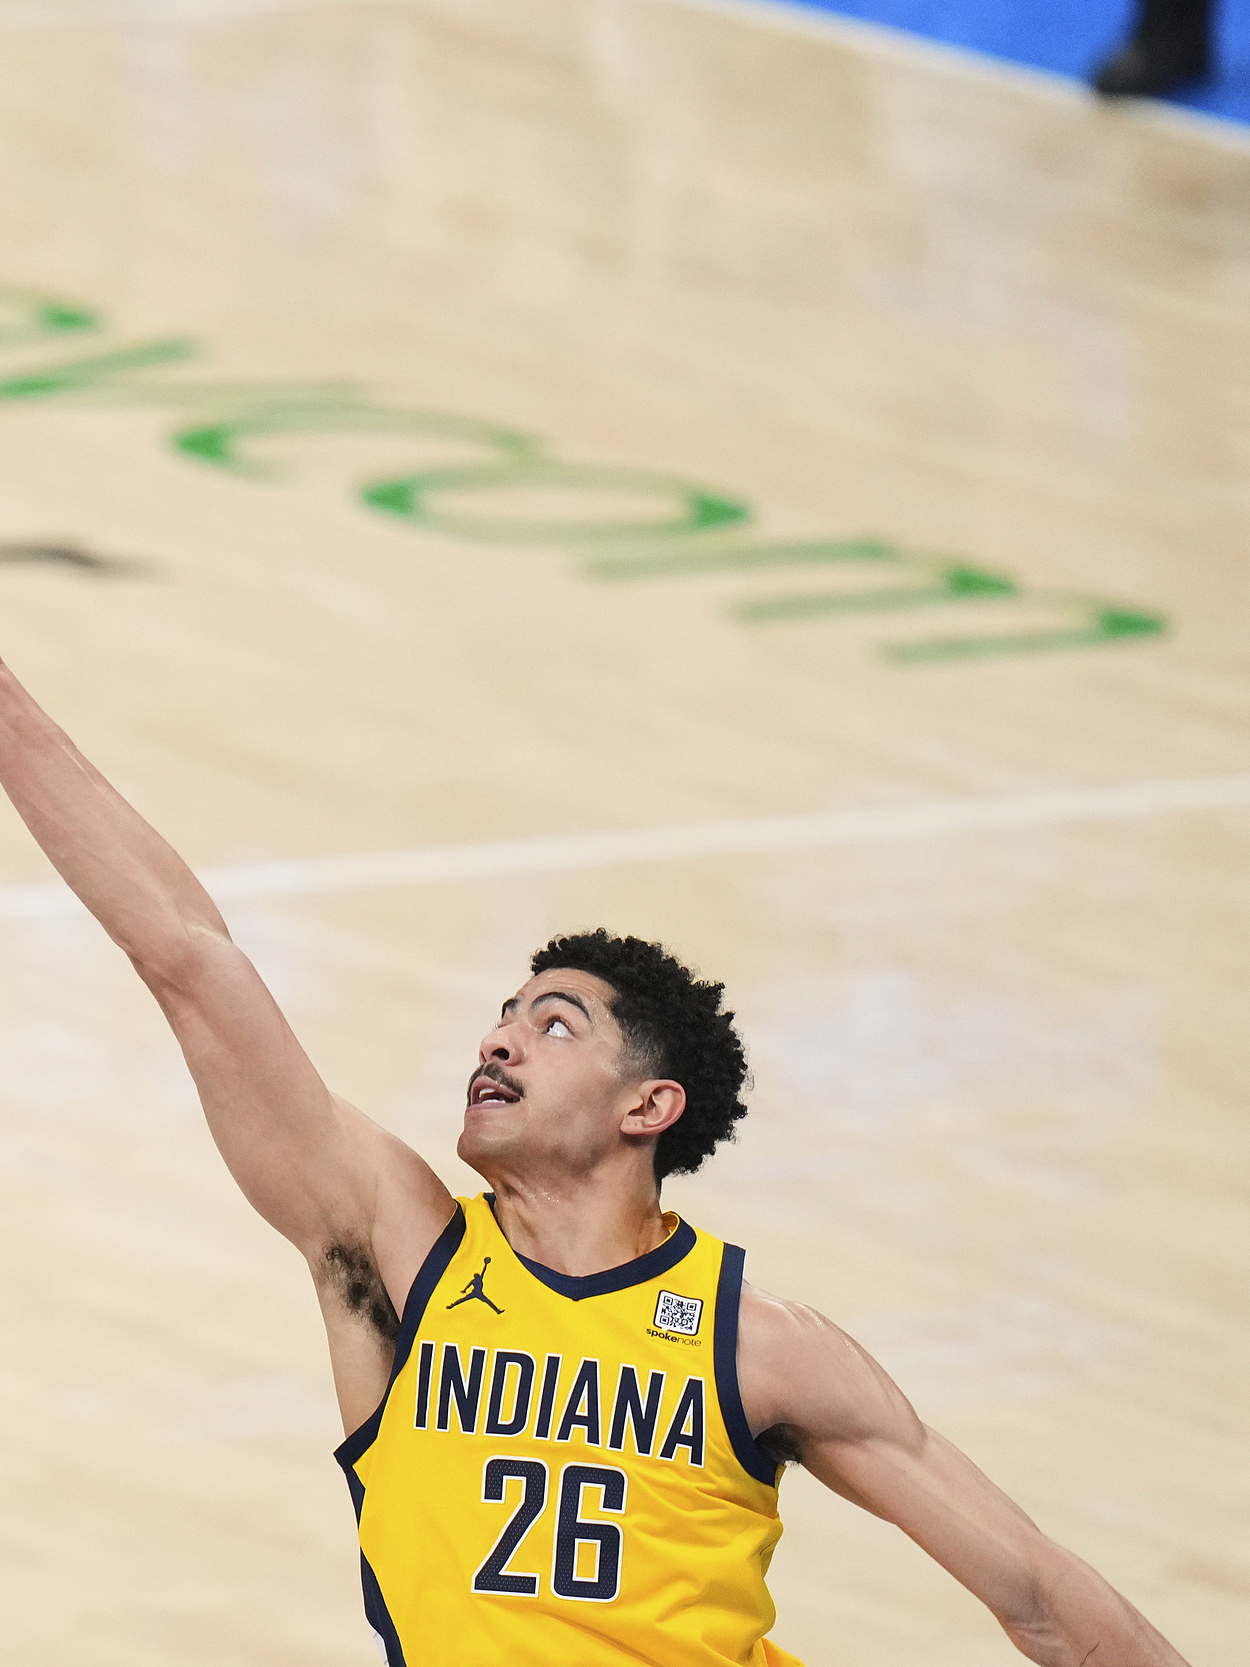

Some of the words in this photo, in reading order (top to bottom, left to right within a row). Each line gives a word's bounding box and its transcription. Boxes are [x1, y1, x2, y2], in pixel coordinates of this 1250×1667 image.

[646, 1327, 702, 1347] spokenote
[414, 1340, 706, 1468] INDIANA
[471, 1455, 628, 1603] 26
